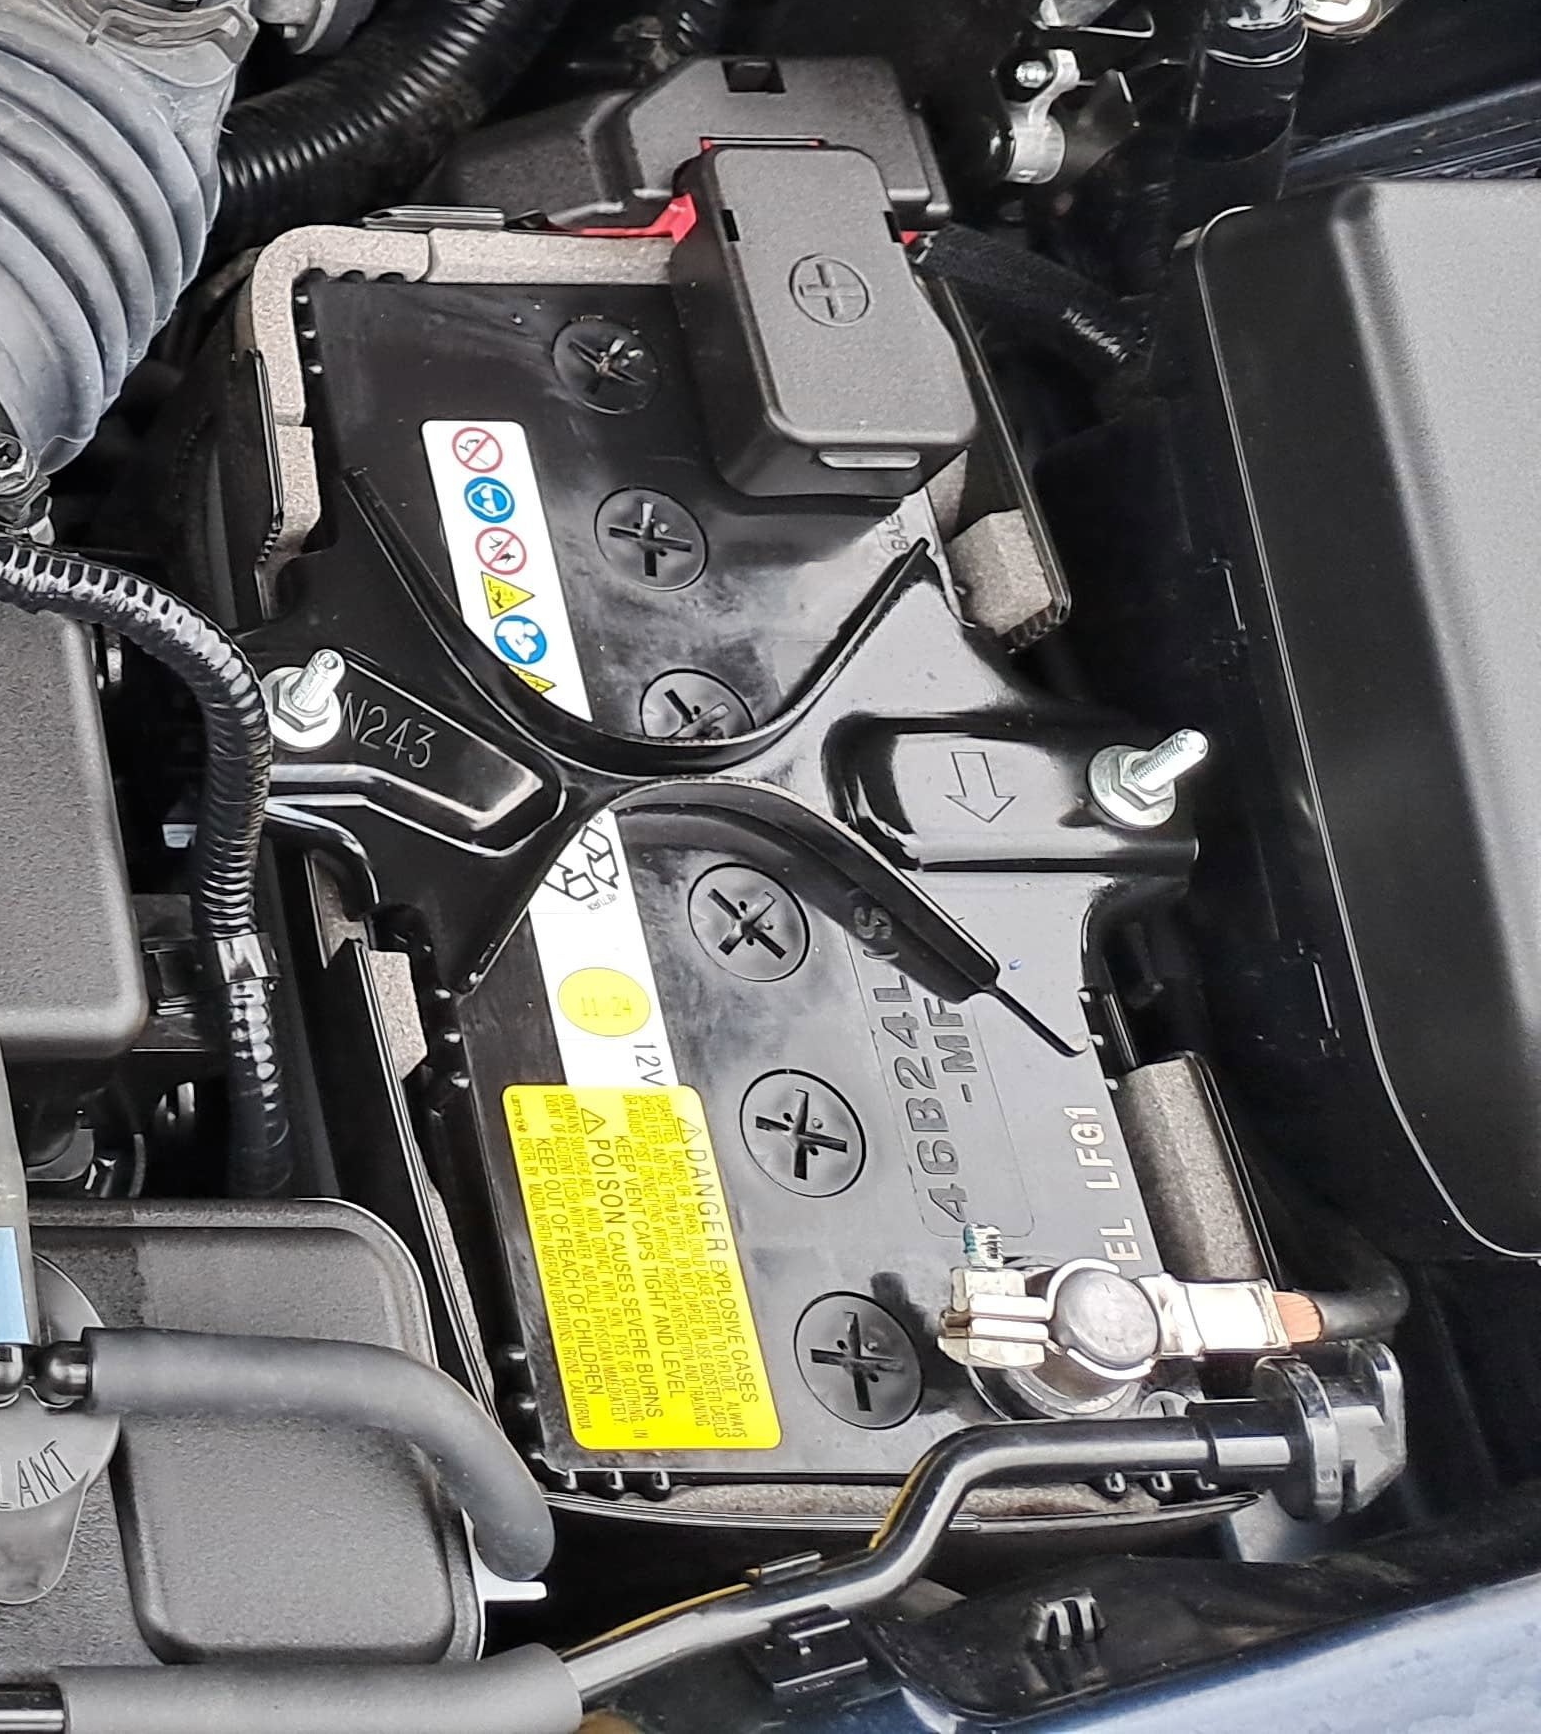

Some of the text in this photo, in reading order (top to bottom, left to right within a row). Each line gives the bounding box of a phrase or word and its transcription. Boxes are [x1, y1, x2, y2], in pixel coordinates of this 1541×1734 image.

[340, 692, 437, 768] N243
[633, 1043, 667, 1087] 12V
[923, 997, 977, 1103] -MF
[533, 1138, 605, 1394] KEEP OUT OF REACH OF CHILDREN
[586, 1140, 664, 1417] POISON CAUSES SEVERE BURNS
[612, 1135, 687, 1398] KEEP VENT CAPS TIGHT AND LEVEL
[683, 1149, 759, 1402] DANGER EXPLOSIVE GASES
[611, 1335, 631, 1354] EYES
[617, 1360, 634, 1372] OR
[691, 1328, 708, 1339] OR
[710, 1341, 727, 1350] TO
